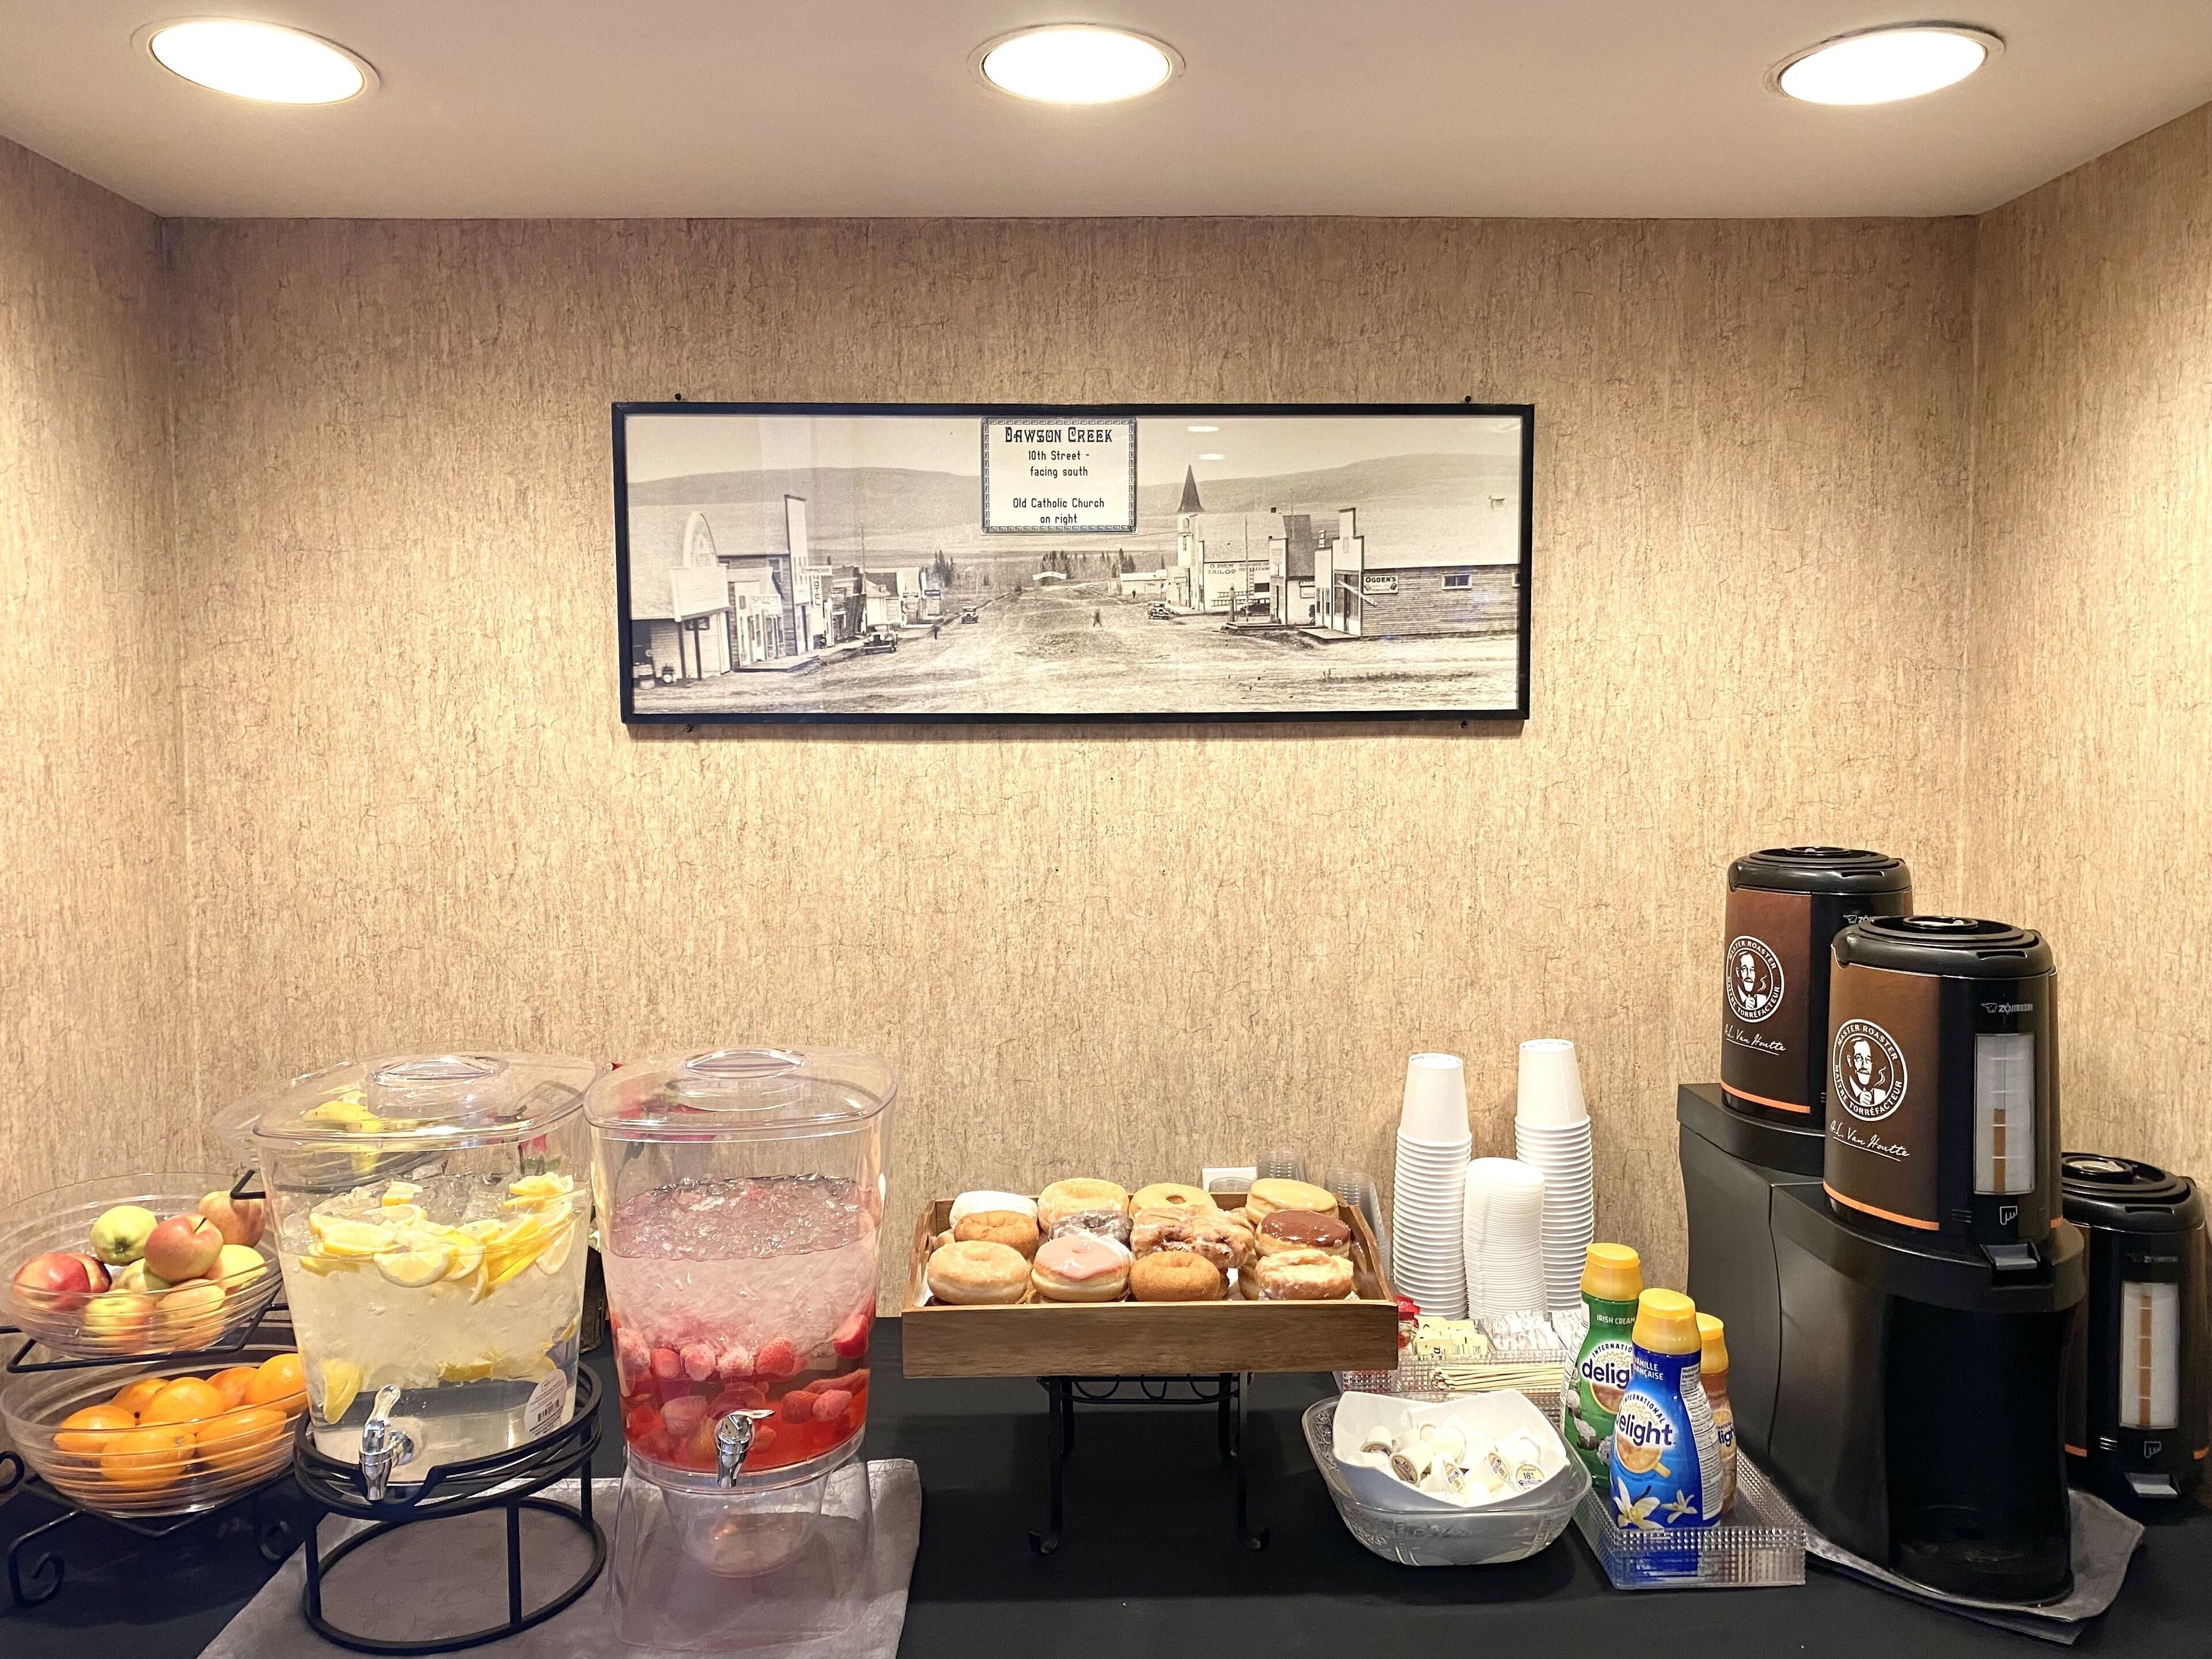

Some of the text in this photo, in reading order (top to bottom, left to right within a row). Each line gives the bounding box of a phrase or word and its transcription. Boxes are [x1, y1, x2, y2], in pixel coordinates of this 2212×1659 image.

[1068, 427, 1112, 442] CREEK
[1028, 450, 1046, 460] 10th
[1051, 450, 1081, 460] Street
[1030, 466, 1088, 478] facing south
[1013, 498, 1104, 507] Old Catholic Church
[1040, 514, 1077, 525] on right
[813, 575, 821, 606] HOTEL
[1729, 940, 1777, 969] MASTER ROASTER
[1737, 986, 1780, 1018] TORRÉFACTEUR
[1837, 1024, 1897, 1060] MASTER ROASTER
[1849, 1080, 1902, 1116] TORRÉFACTEUR
[1847, 1127, 1865, 1145] Van
[1867, 1134, 1910, 1157] Houtte
[1597, 1315, 1613, 1324] IRISH
[1592, 1343, 1633, 1357] INTERNATIO
[1582, 1358, 1633, 1389] delig
[1623, 1394, 1665, 1423] INTERNATIONAL
